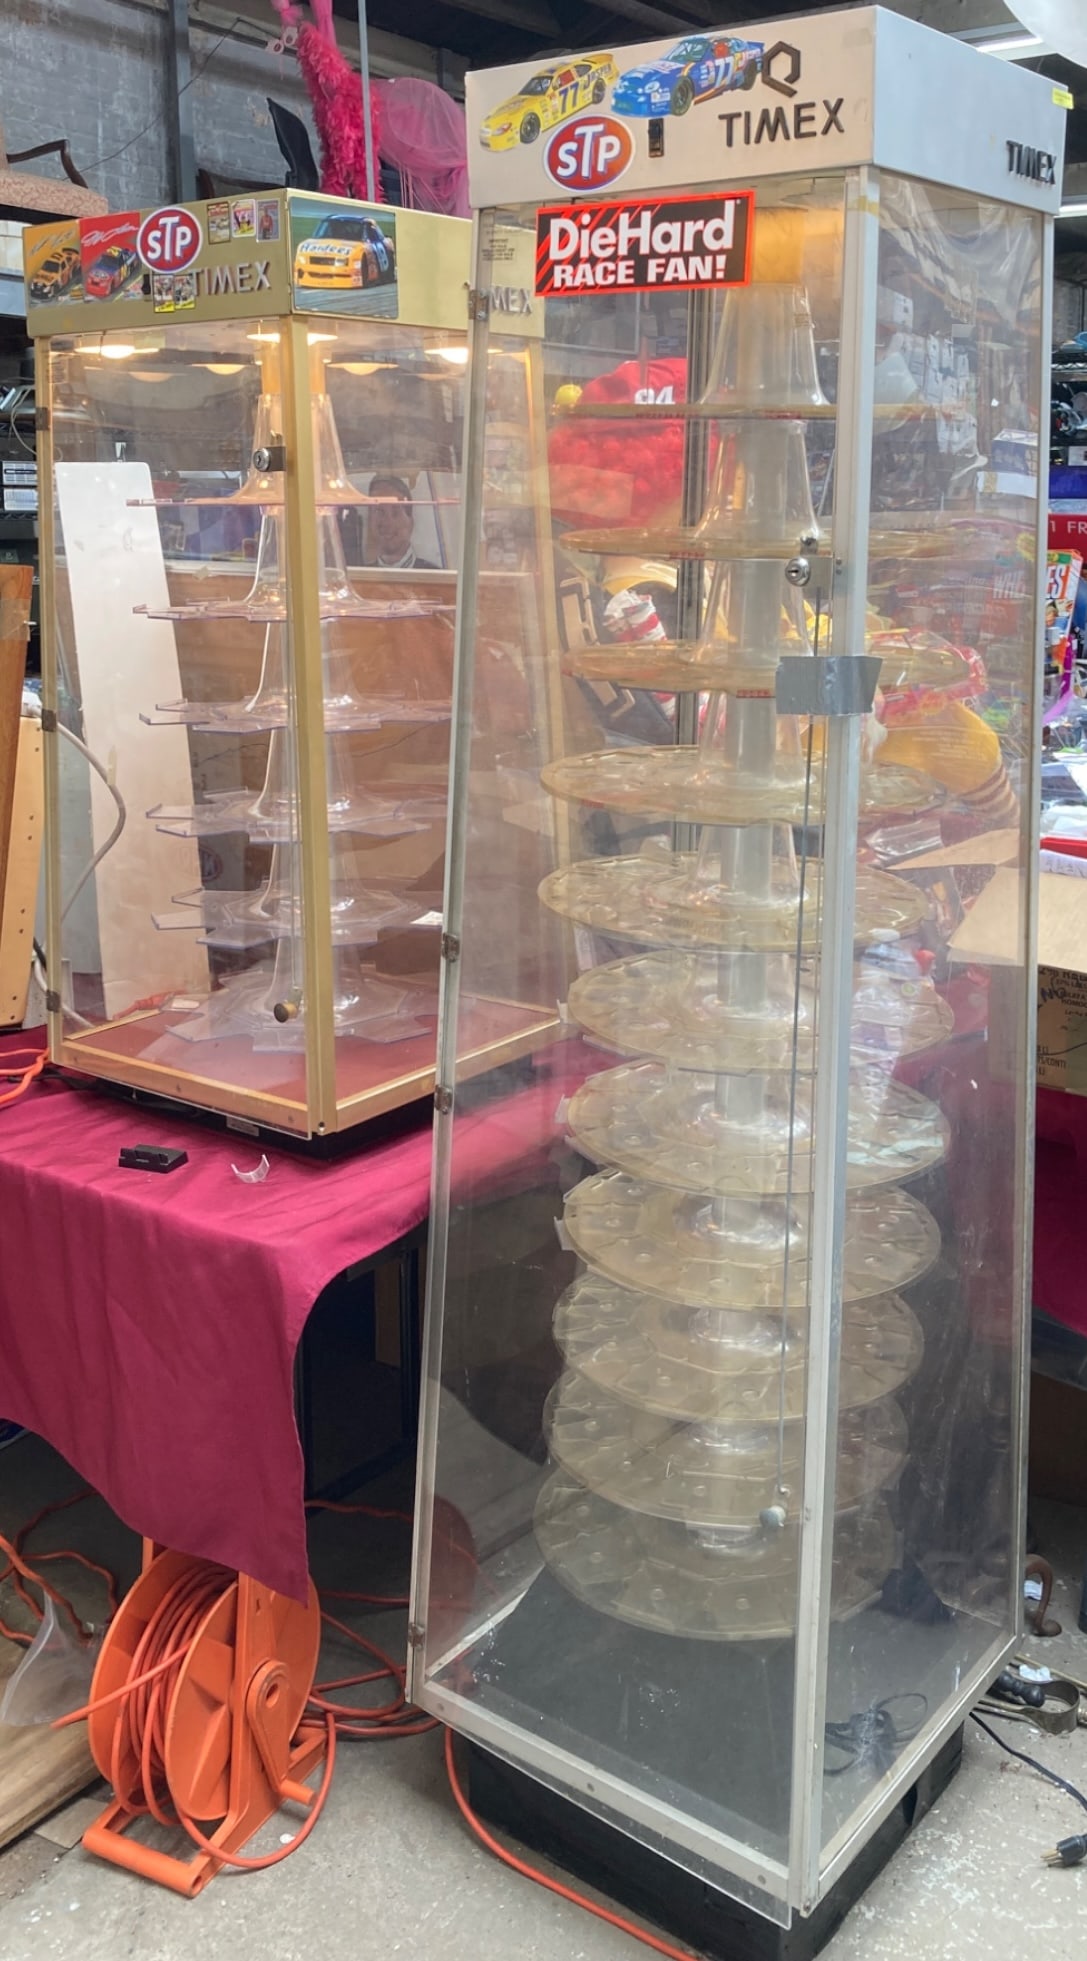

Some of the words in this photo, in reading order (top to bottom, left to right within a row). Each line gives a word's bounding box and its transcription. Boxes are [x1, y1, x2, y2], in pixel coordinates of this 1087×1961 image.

[714, 55, 734, 88] 77
[559, 81, 580, 114] 77
[718, 98, 845, 148] TIMEX
[556, 123, 622, 179] STP
[1005, 140, 1057, 185] TIMEX
[147, 215, 192, 262] STP
[549, 199, 736, 261] DieHard
[188, 260, 272, 297] TIMEX
[553, 260, 635, 289] RACE
[647, 254, 727, 283] FAN!
[490, 285, 532, 314] MEX
